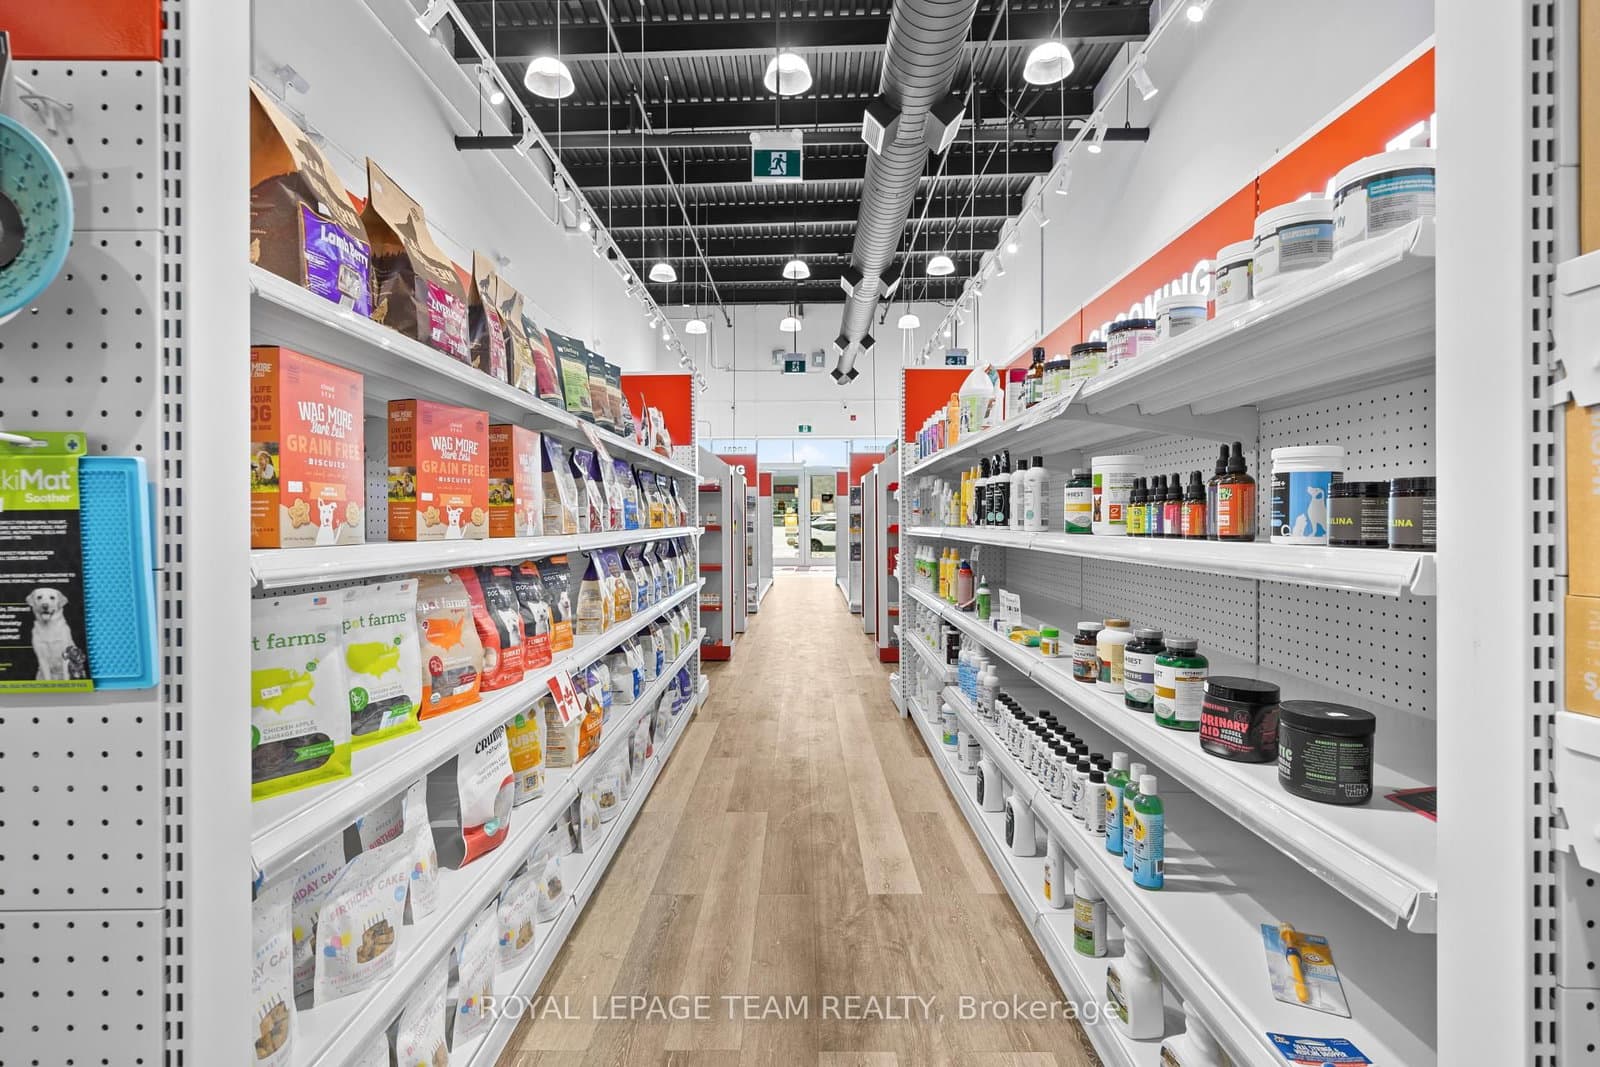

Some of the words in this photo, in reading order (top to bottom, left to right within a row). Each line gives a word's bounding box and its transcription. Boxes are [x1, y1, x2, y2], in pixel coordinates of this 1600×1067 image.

[253, 385, 273, 393] LIFE
[297, 401, 325, 422] WAG
[327, 404, 353, 433] MORE
[286, 433, 333, 457] GRAIN
[334, 440, 360, 462] FREE
[391, 441, 412, 453] DOG
[430, 435, 454, 451] WAG
[455, 437, 479, 456] MORE
[308, 457, 345, 470] BISCUITS
[422, 460, 459, 475] GRAIN
[461, 464, 486, 478] FREE
[438, 476, 472, 485] BISCUITS
[25, 492, 69, 502] Soother
[368, 613, 407, 626] farms
[266, 632, 326, 649] farms
[263, 723, 294, 735] CHICKEN
[1201, 712, 1249, 734] URINARY
[1201, 724, 1220, 738] AID
[329, 883, 377, 922] BIRTHDAY
[377, 872, 407, 891] CAKE
